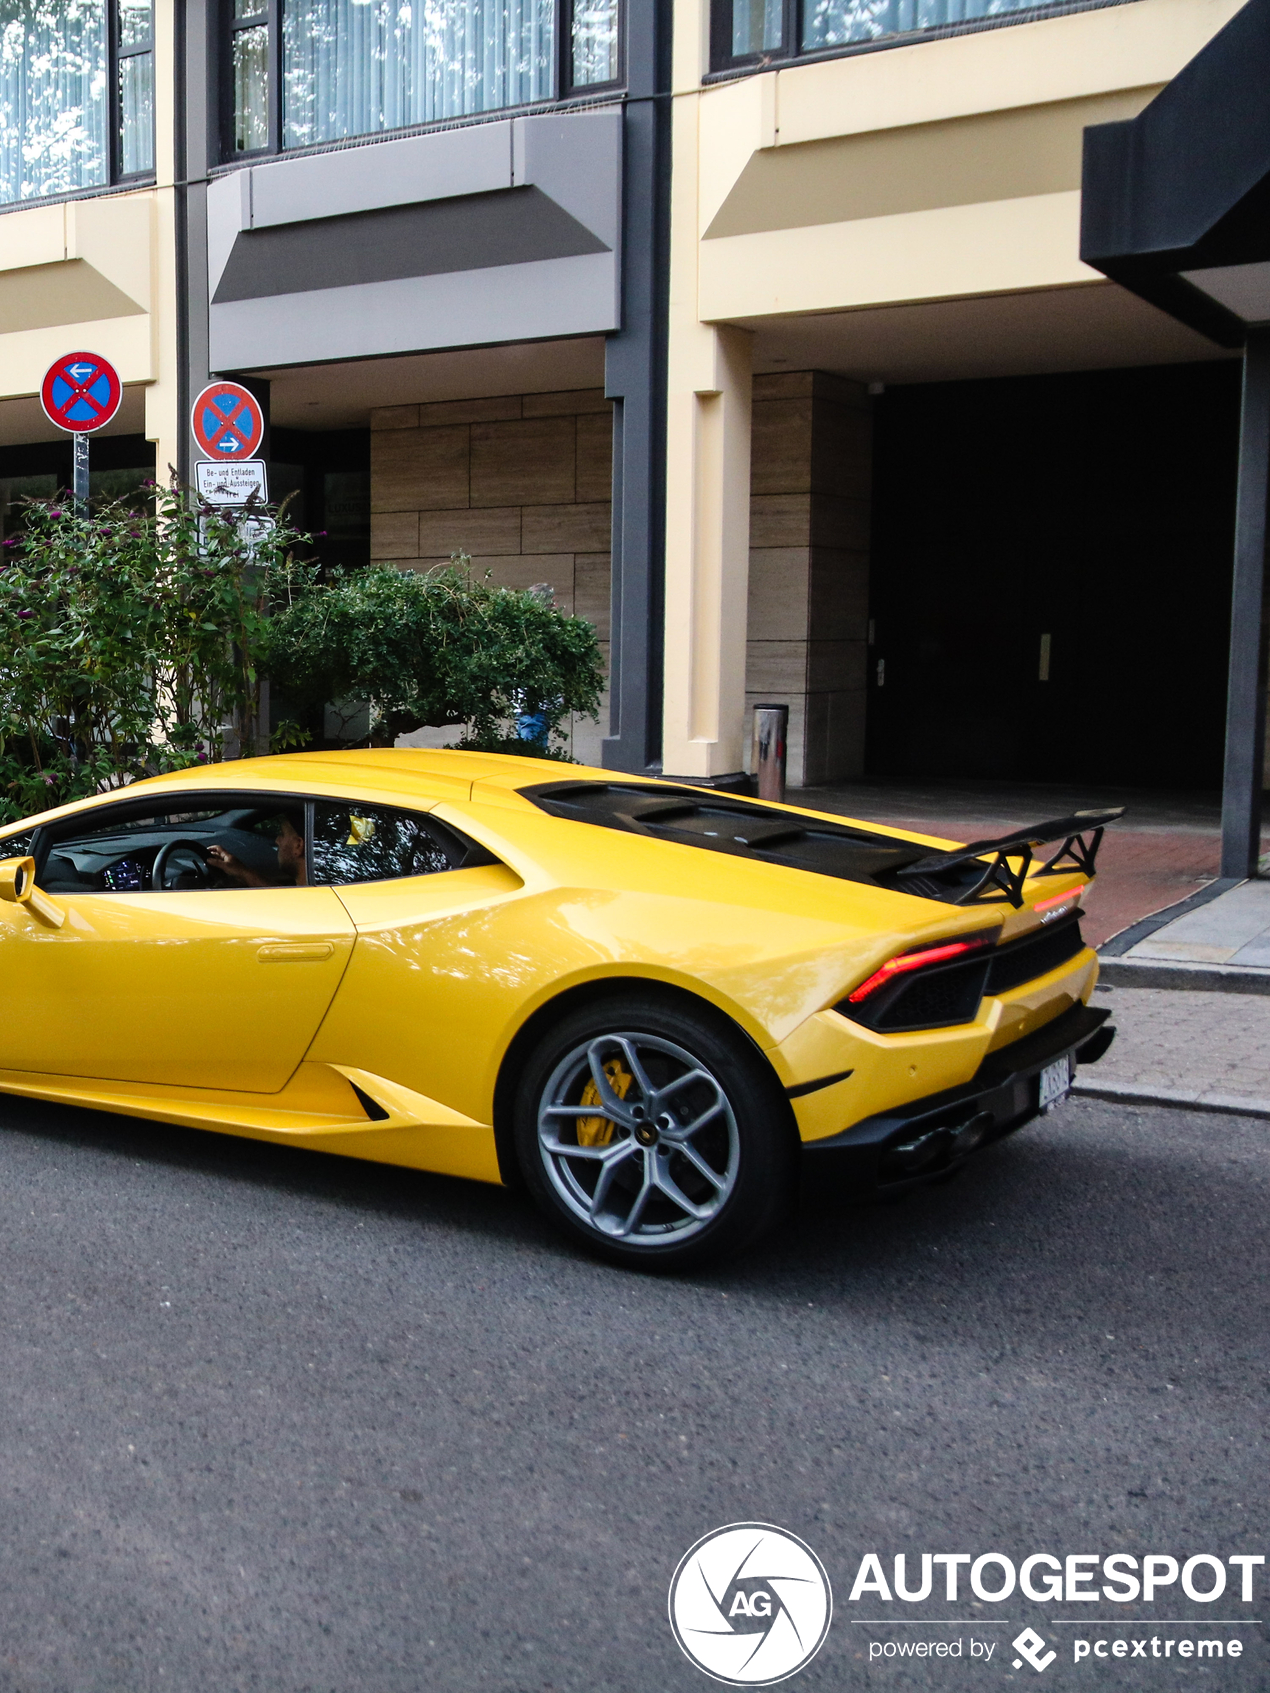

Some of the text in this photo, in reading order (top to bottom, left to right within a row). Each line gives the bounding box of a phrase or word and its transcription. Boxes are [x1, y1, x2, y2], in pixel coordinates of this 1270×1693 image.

[206, 467, 255, 477] Be- und Entladen
[203, 478, 260, 489] Ein- und Aussteigen
